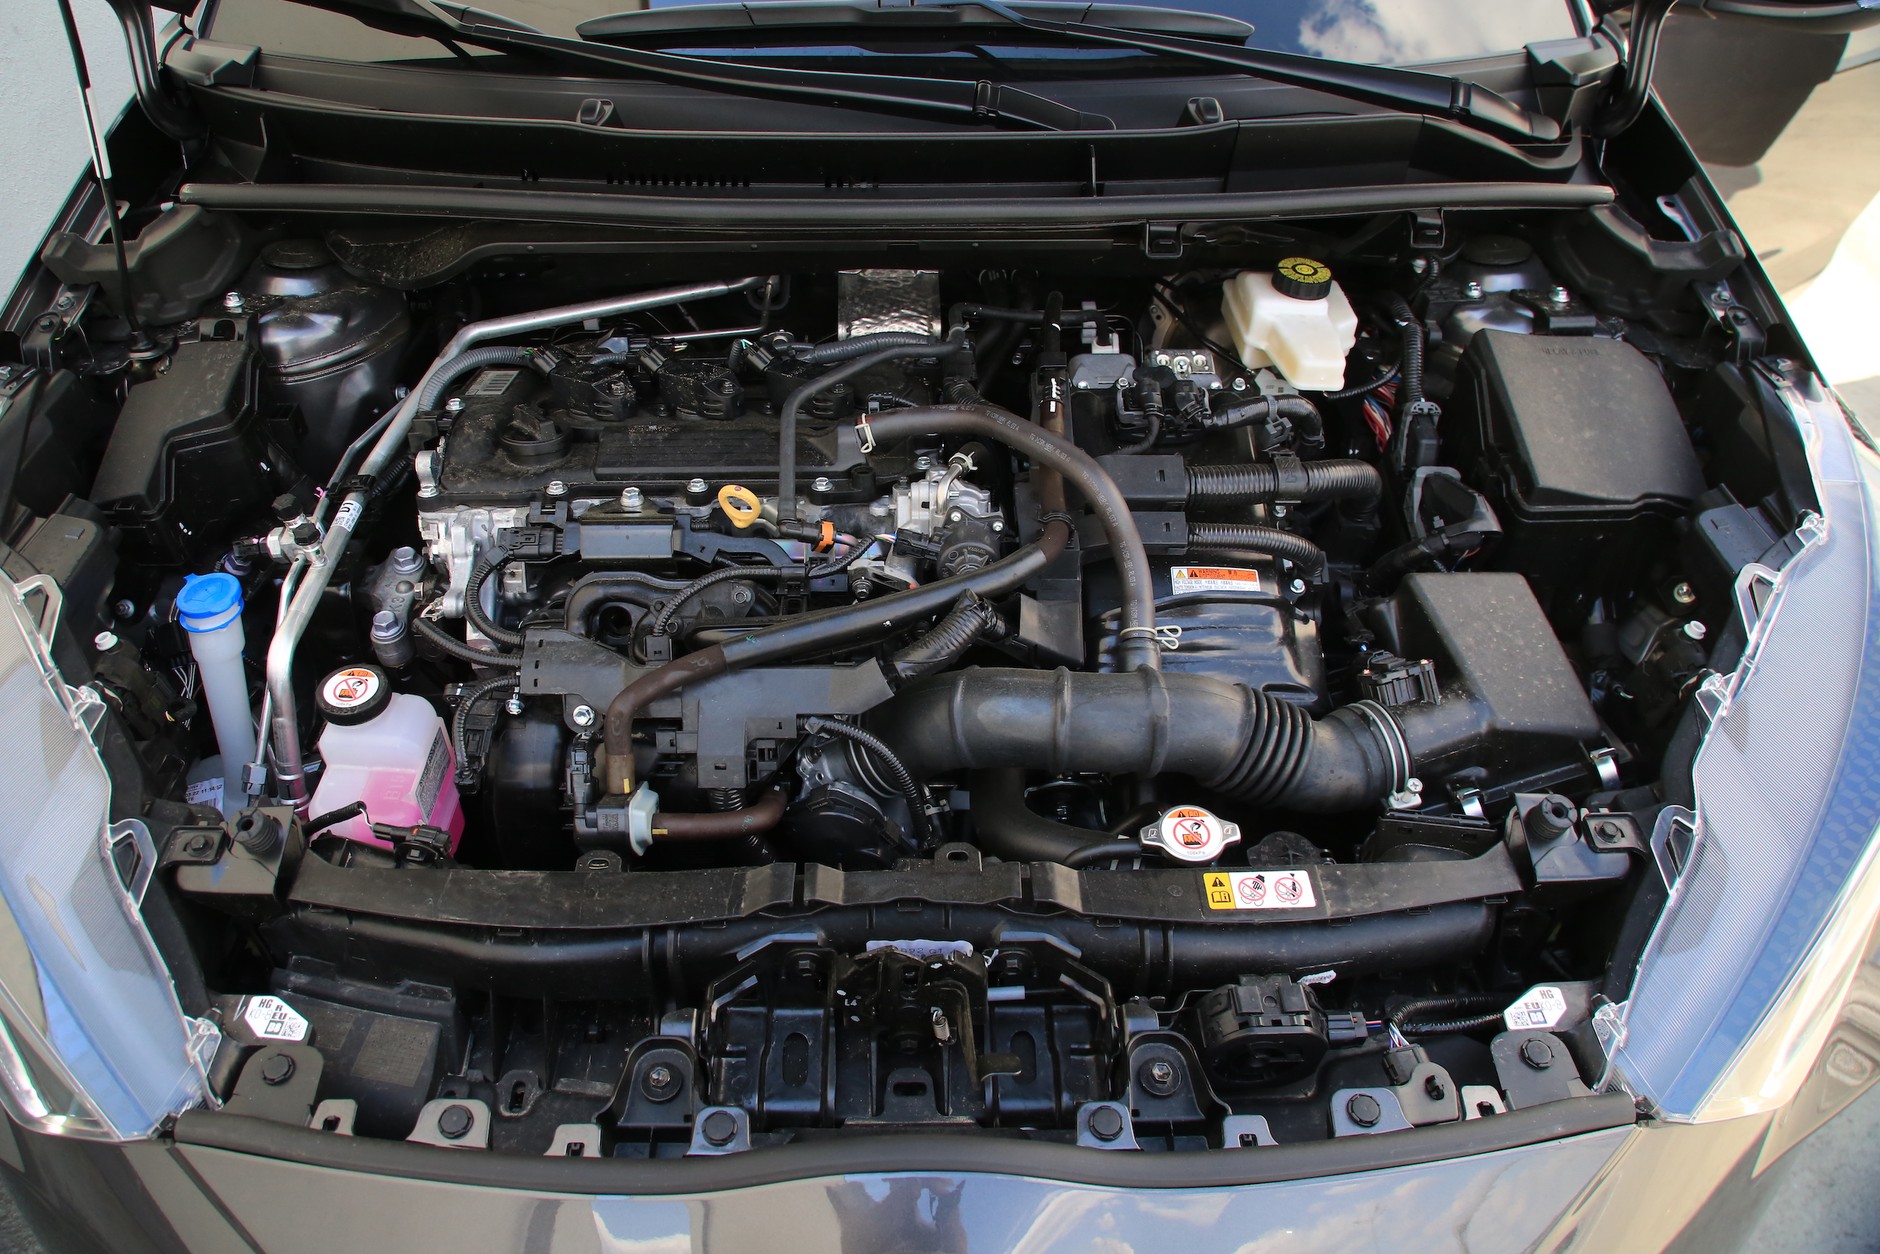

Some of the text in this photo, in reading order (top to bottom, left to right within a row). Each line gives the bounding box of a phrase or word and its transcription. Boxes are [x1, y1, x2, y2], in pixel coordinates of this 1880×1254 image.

[1539, 989, 1555, 1000] HG
[259, 998, 273, 1008] HG
[1524, 1002, 1540, 1010] EU
[272, 1012, 288, 1020] EU
